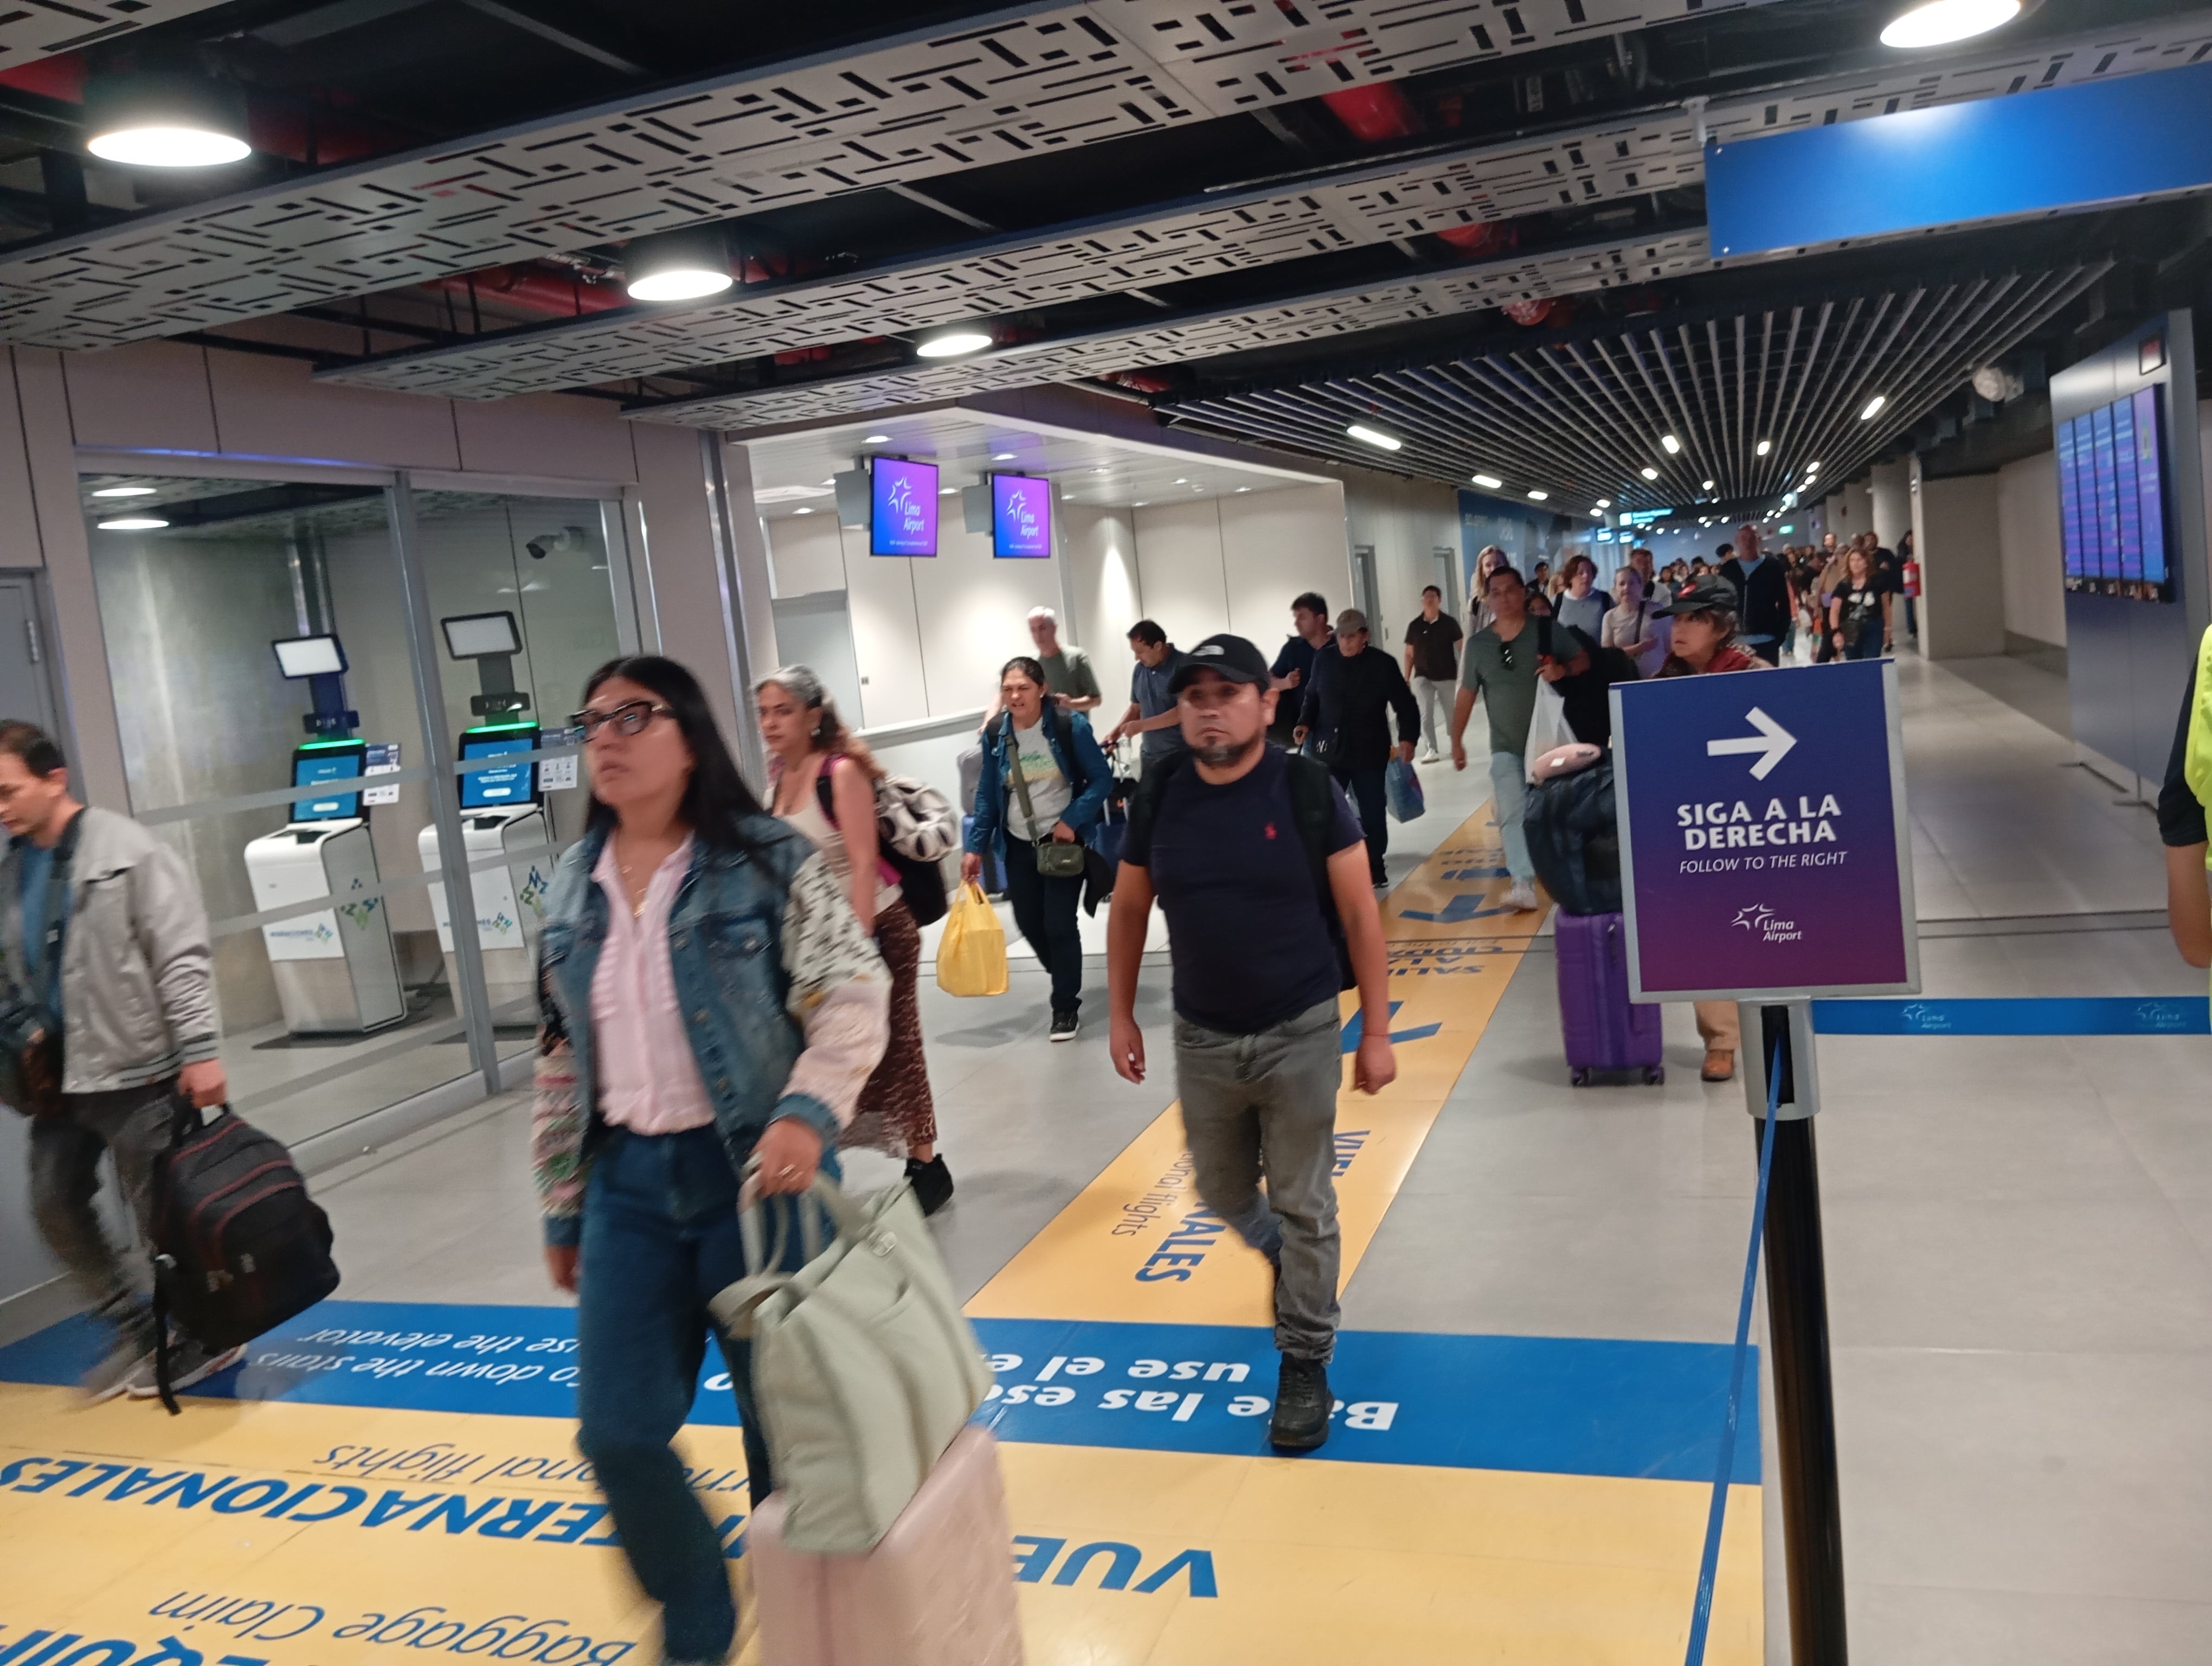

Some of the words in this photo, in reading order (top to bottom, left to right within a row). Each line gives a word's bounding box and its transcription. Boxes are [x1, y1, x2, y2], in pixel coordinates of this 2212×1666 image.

[904, 502, 921, 517] Lima
[1021, 511, 1035, 523] Lima
[903, 517, 925, 535] Airport
[1020, 524, 1039, 538] Airport
[1677, 801, 1752, 826] SIGA
[1764, 798, 1787, 821] A
[1799, 794, 1841, 818] LA
[1684, 820, 1837, 850] DERECHA
[1680, 858, 1740, 874] FOLLOW
[1744, 856, 1764, 870] TO
[1769, 854, 1797, 868] THE
[1801, 851, 1848, 866] RIGHT
[1764, 919, 1794, 931] Lima
[1763, 930, 1802, 944] Airport
[1111, 1193, 1178, 1236] flights
[296, 1328, 453, 1352] elevator
[453, 1335, 524, 1354] the
[251, 1353, 356, 1372] stairs
[351, 1357, 425, 1379] the
[426, 1361, 544, 1385] down
[1034, 1356, 1105, 1381] el
[1128, 1359, 1250, 1382] use
[1098, 1389, 1204, 1422] las
[312, 1443, 487, 1482] flights
[1013, 1535, 1218, 1598] VUE
[148, 1591, 325, 1641] Claim
[332, 1606, 638, 1666] Baggage
